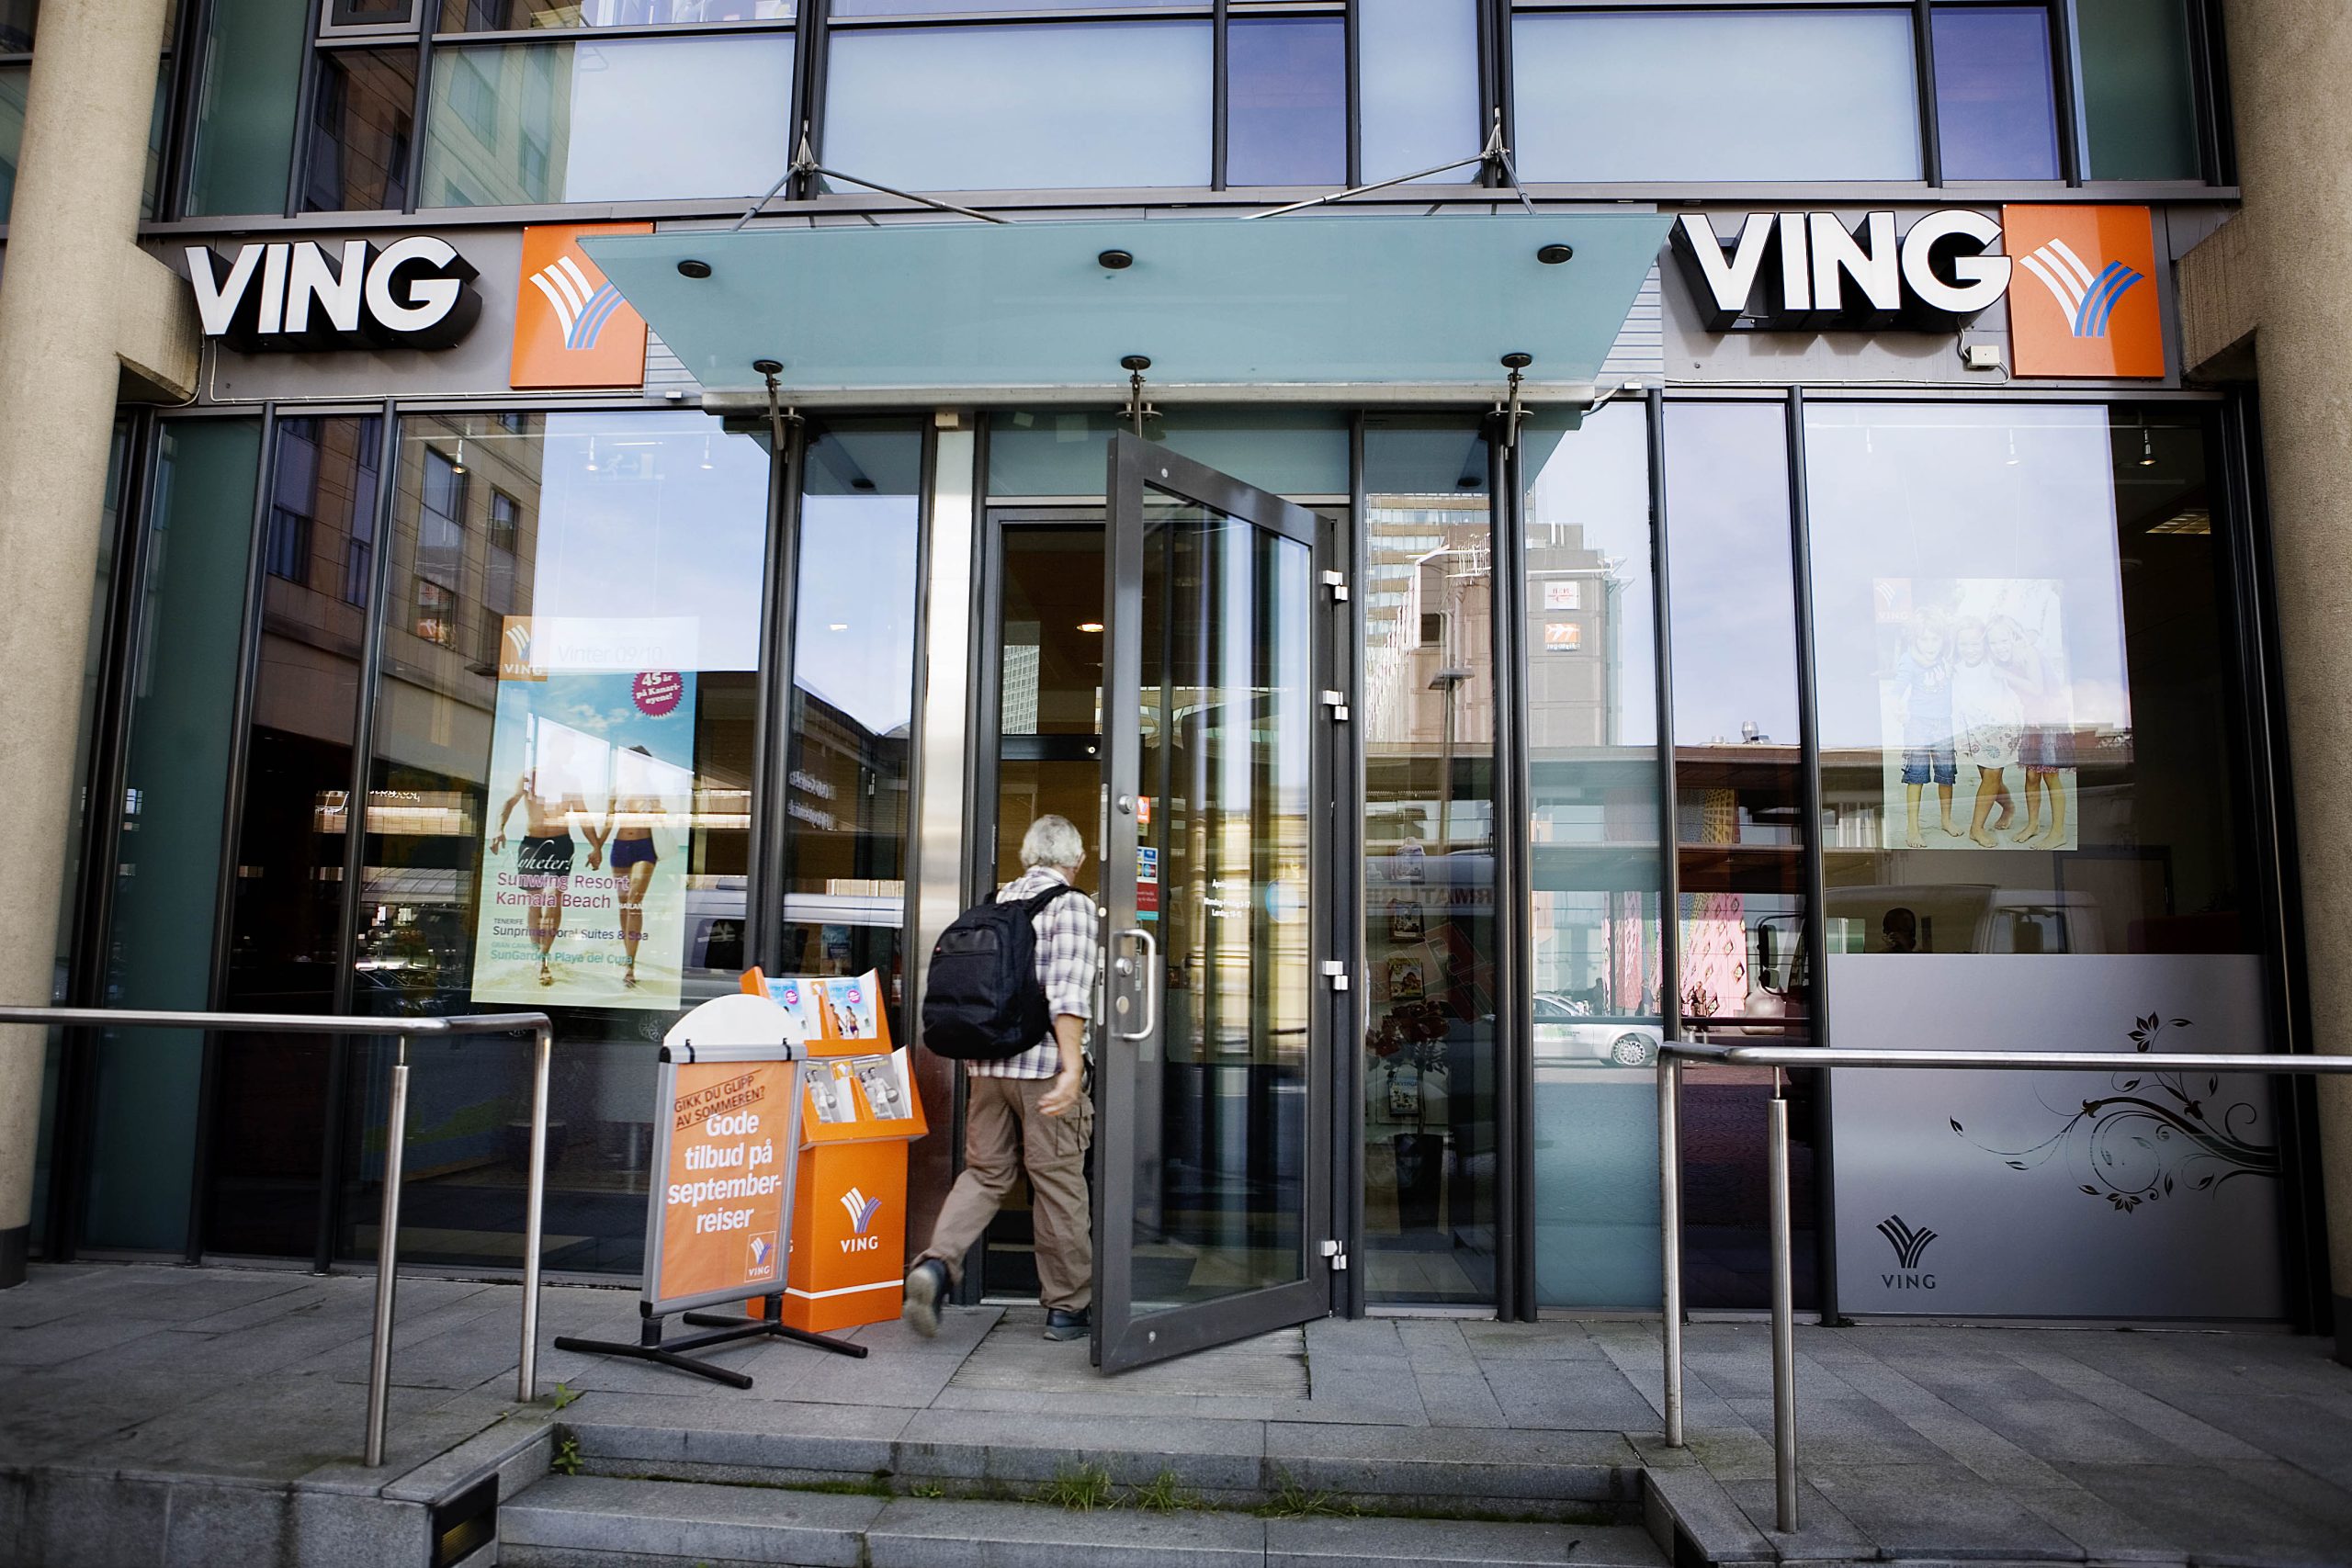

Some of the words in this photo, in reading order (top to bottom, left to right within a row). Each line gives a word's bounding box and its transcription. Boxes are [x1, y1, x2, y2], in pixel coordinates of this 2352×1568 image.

[1678, 209, 2013, 313] VING
[185, 236, 461, 336] VING
[503, 663, 544, 676] VING
[641, 671, 662, 686] 45
[662, 673, 673, 682] år
[635, 689, 648, 699] på
[648, 682, 681, 696] Kanari-
[497, 873, 570, 891] Sunwing
[574, 874, 630, 891] Resort
[496, 891, 557, 908] Kamala
[561, 893, 611, 908] Beach
[494, 918, 524, 926] TENERIFE
[492, 926, 547, 938] Sunprime
[581, 929, 615, 940] Suites
[616, 930, 626, 940] &
[491, 950, 550, 962] SunGarden
[554, 952, 584, 964] Playa
[587, 953, 604, 964] del
[606, 954, 633, 965] Cura
[674, 1094, 702, 1113] GIKK
[705, 1087, 721, 1102] DU
[723, 1075, 754, 1095] GLIPP
[676, 1112, 693, 1128] AV
[695, 1085, 765, 1122] SOMMEREN?
[706, 1110, 760, 1137] Gode
[684, 1142, 744, 1171] tilbud
[749, 1137, 773, 1170] på
[667, 1172, 782, 1208] september-
[695, 1207, 755, 1235] reiser
[840, 1235, 879, 1254] VING
[748, 1265, 771, 1277] VING
[1881, 1273, 1936, 1290] VING
